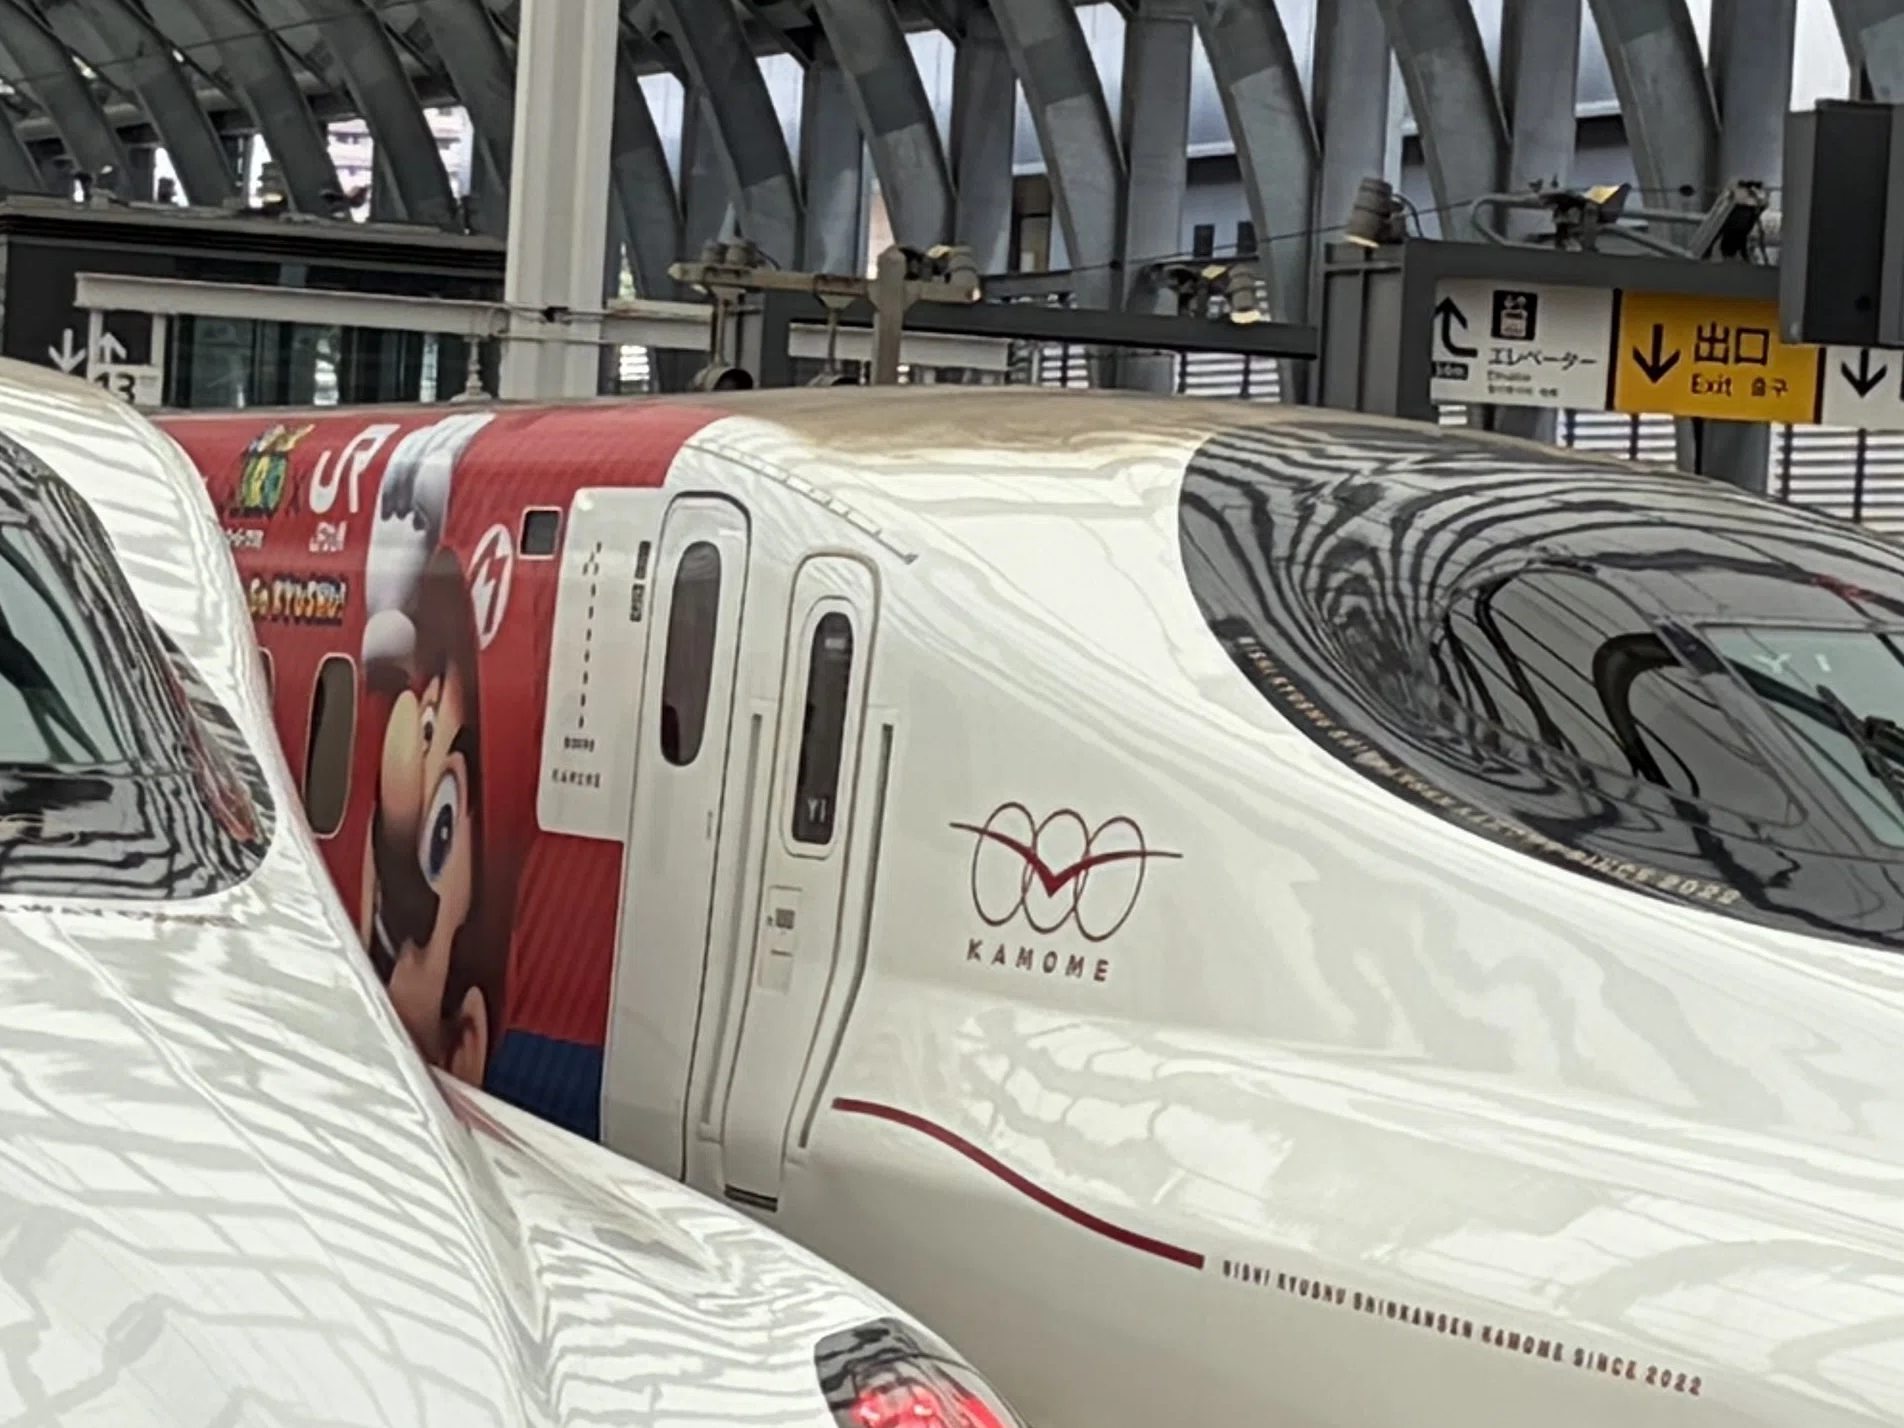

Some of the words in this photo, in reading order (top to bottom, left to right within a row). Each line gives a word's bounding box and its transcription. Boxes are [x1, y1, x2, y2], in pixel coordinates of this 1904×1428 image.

[1488, 346, 1598, 371] エレベーター
[1695, 321, 1771, 367] 出口
[1690, 373, 1733, 397] Exit
[308, 423, 402, 514] JR
[965, 937, 1111, 982] KAMOME
[1481, 1323, 1565, 1363] KAMOME
[1572, 1346, 1639, 1381] SINCE
[1645, 1364, 1703, 1398] 2022
